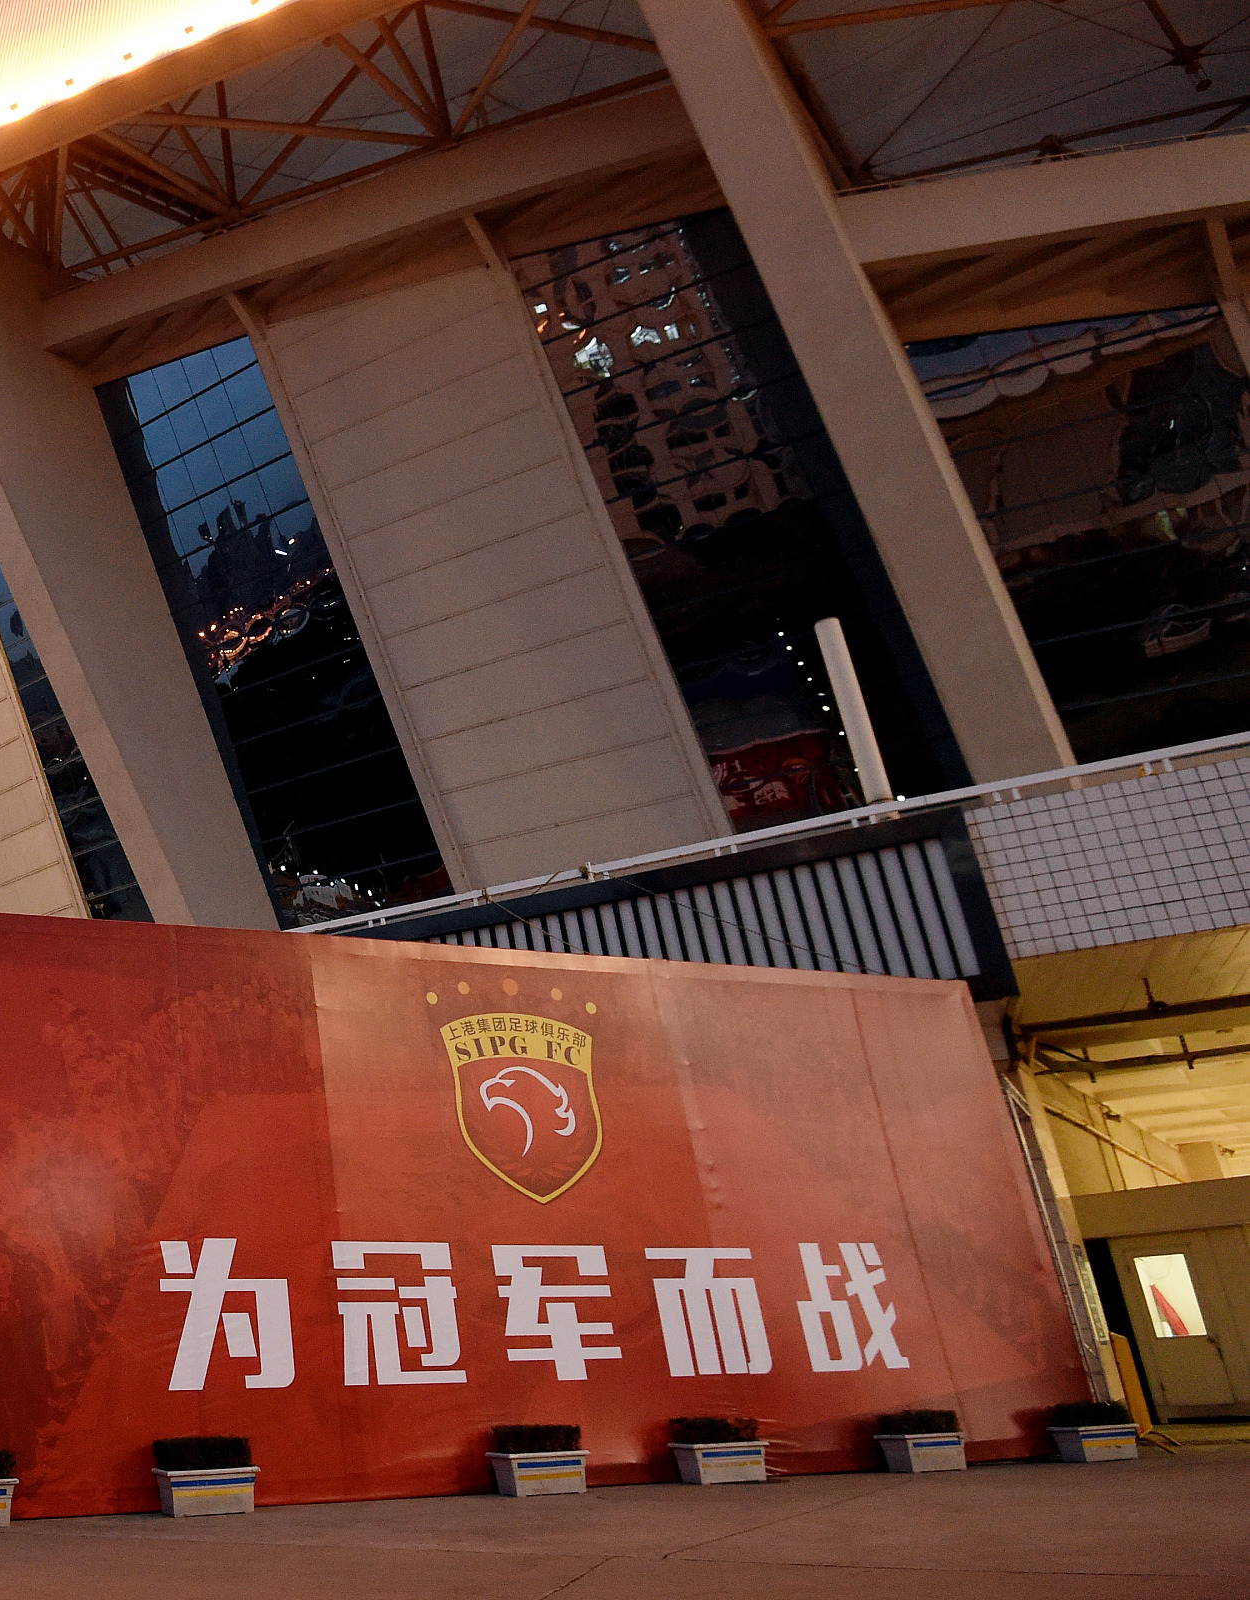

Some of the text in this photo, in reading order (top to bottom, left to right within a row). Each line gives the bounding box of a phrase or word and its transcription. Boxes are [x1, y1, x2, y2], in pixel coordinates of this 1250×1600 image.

[448, 1017, 587, 1048] 上港集团足球俱乐部
[454, 1035, 582, 1065] SIPG FC
[159, 1238, 910, 1391] 为冠军而战
